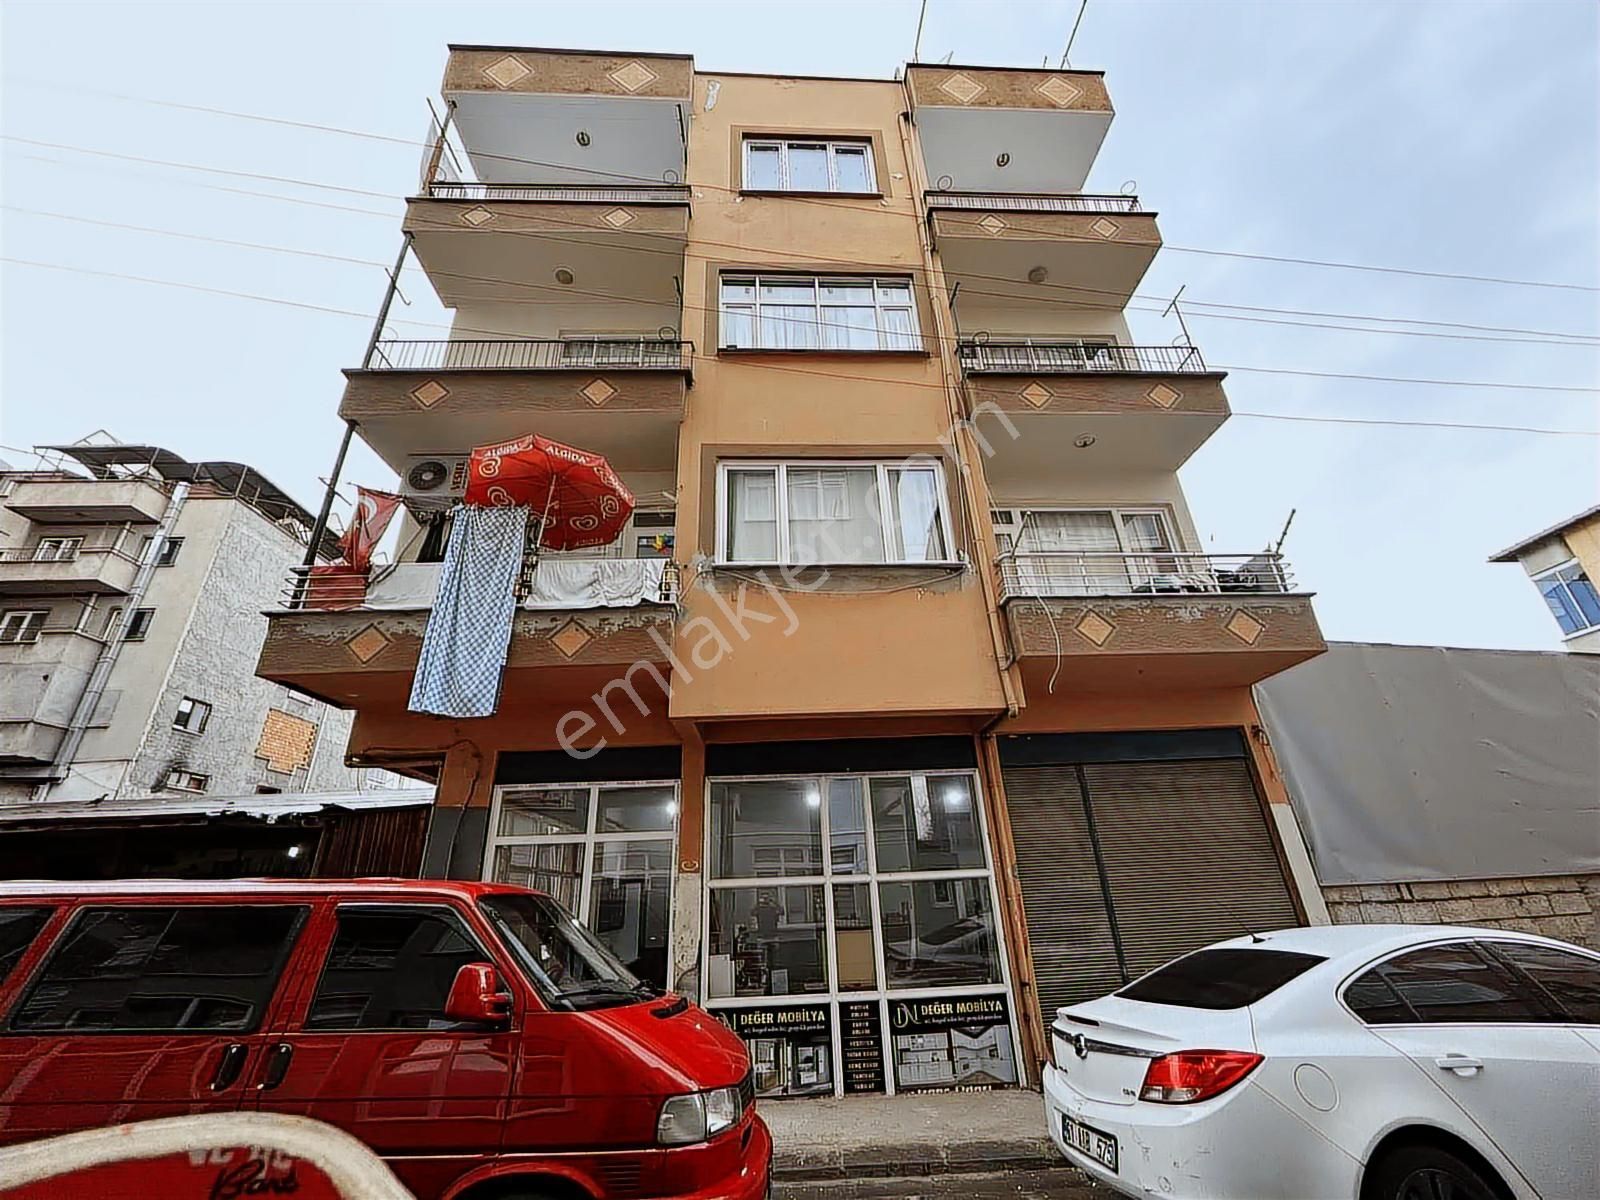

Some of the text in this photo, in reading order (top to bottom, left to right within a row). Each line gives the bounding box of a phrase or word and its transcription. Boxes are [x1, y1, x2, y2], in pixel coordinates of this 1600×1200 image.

[546, 445, 588, 465] ALGIDA
[921, 998, 1003, 1016] DEĞER MOBİLYA
[740, 1010, 774, 1025] DEĞER
[777, 1008, 825, 1024] MOBİLYA
